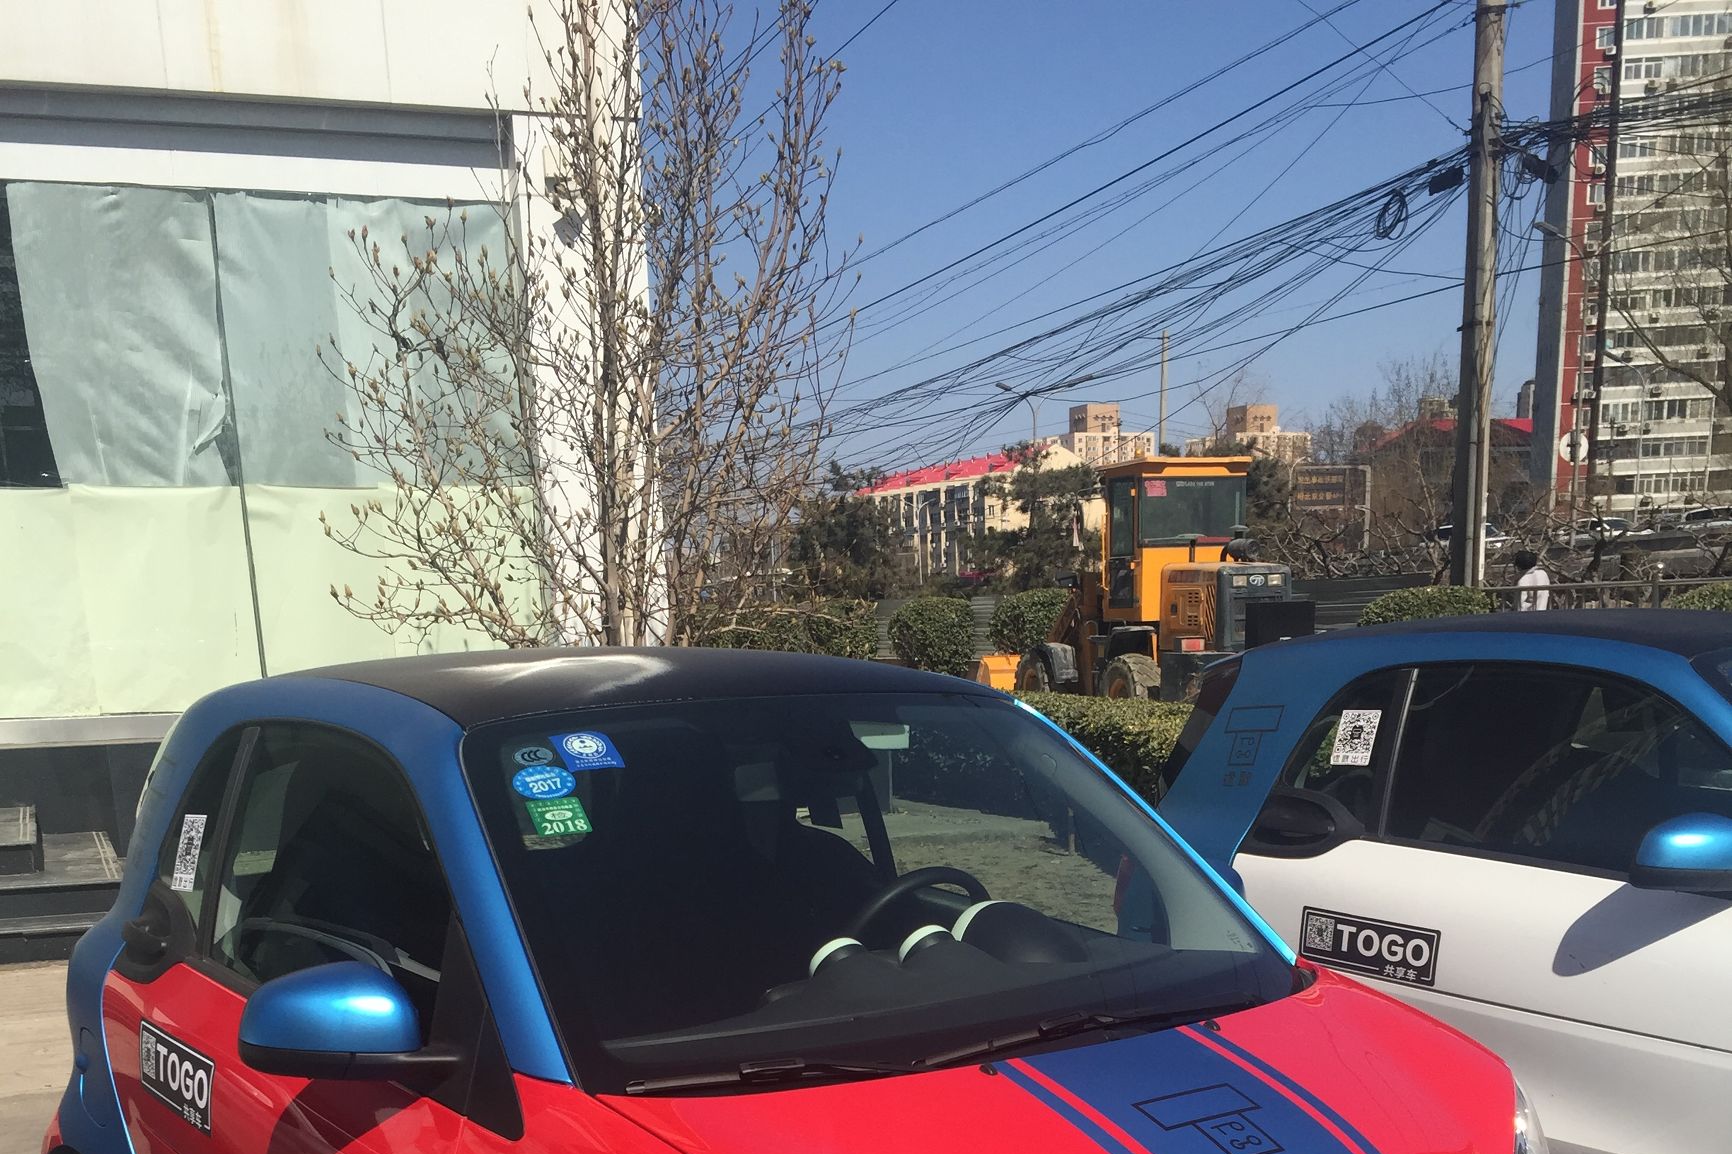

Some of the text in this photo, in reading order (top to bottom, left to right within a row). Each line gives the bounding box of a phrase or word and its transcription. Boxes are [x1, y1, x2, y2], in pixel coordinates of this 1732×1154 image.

[529, 778, 562, 793] 2017
[541, 819, 588, 835] 2018
[1336, 923, 1430, 967] TOGO
[1383, 964, 1418, 981] 共享车
[156, 1043, 209, 1109] TOGO
